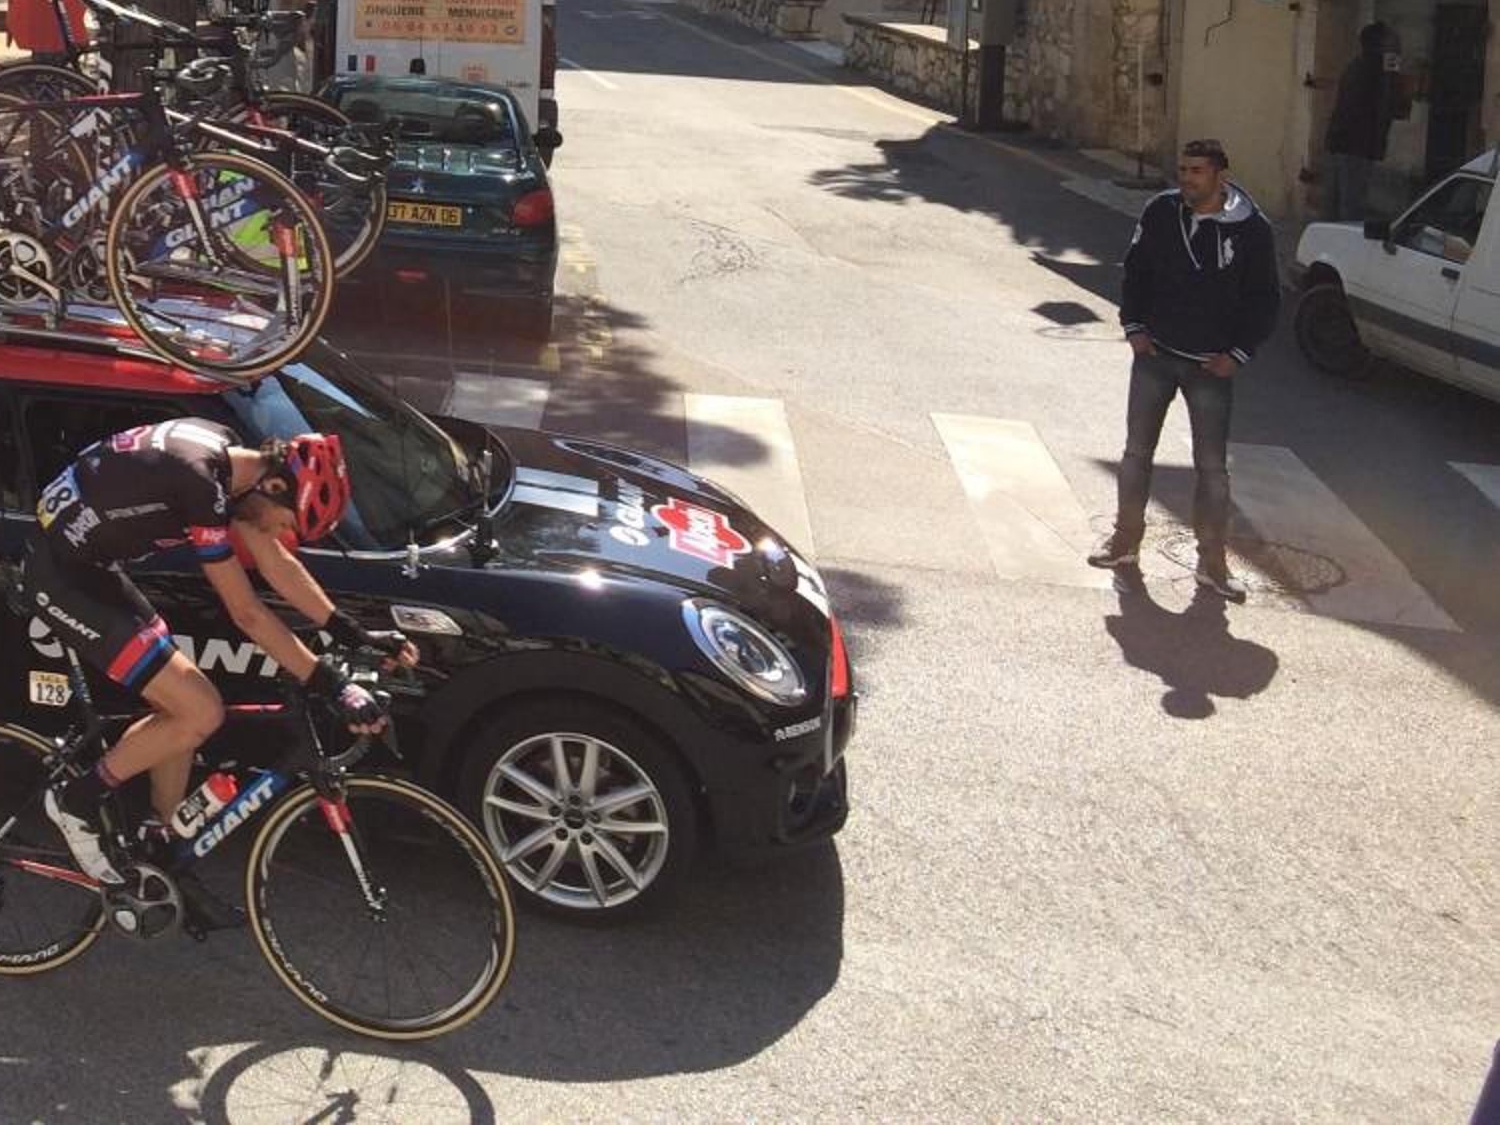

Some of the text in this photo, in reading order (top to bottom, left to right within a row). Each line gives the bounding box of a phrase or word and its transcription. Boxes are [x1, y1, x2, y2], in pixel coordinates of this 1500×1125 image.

[447, 7, 517, 20] MENUISERIE
[62, 155, 132, 228] GIANT
[411, 206, 437, 222] AZN
[48, 606, 101, 640] GIANT
[36, 682, 66, 704] 128
[194, 777, 274, 858] GIANT
